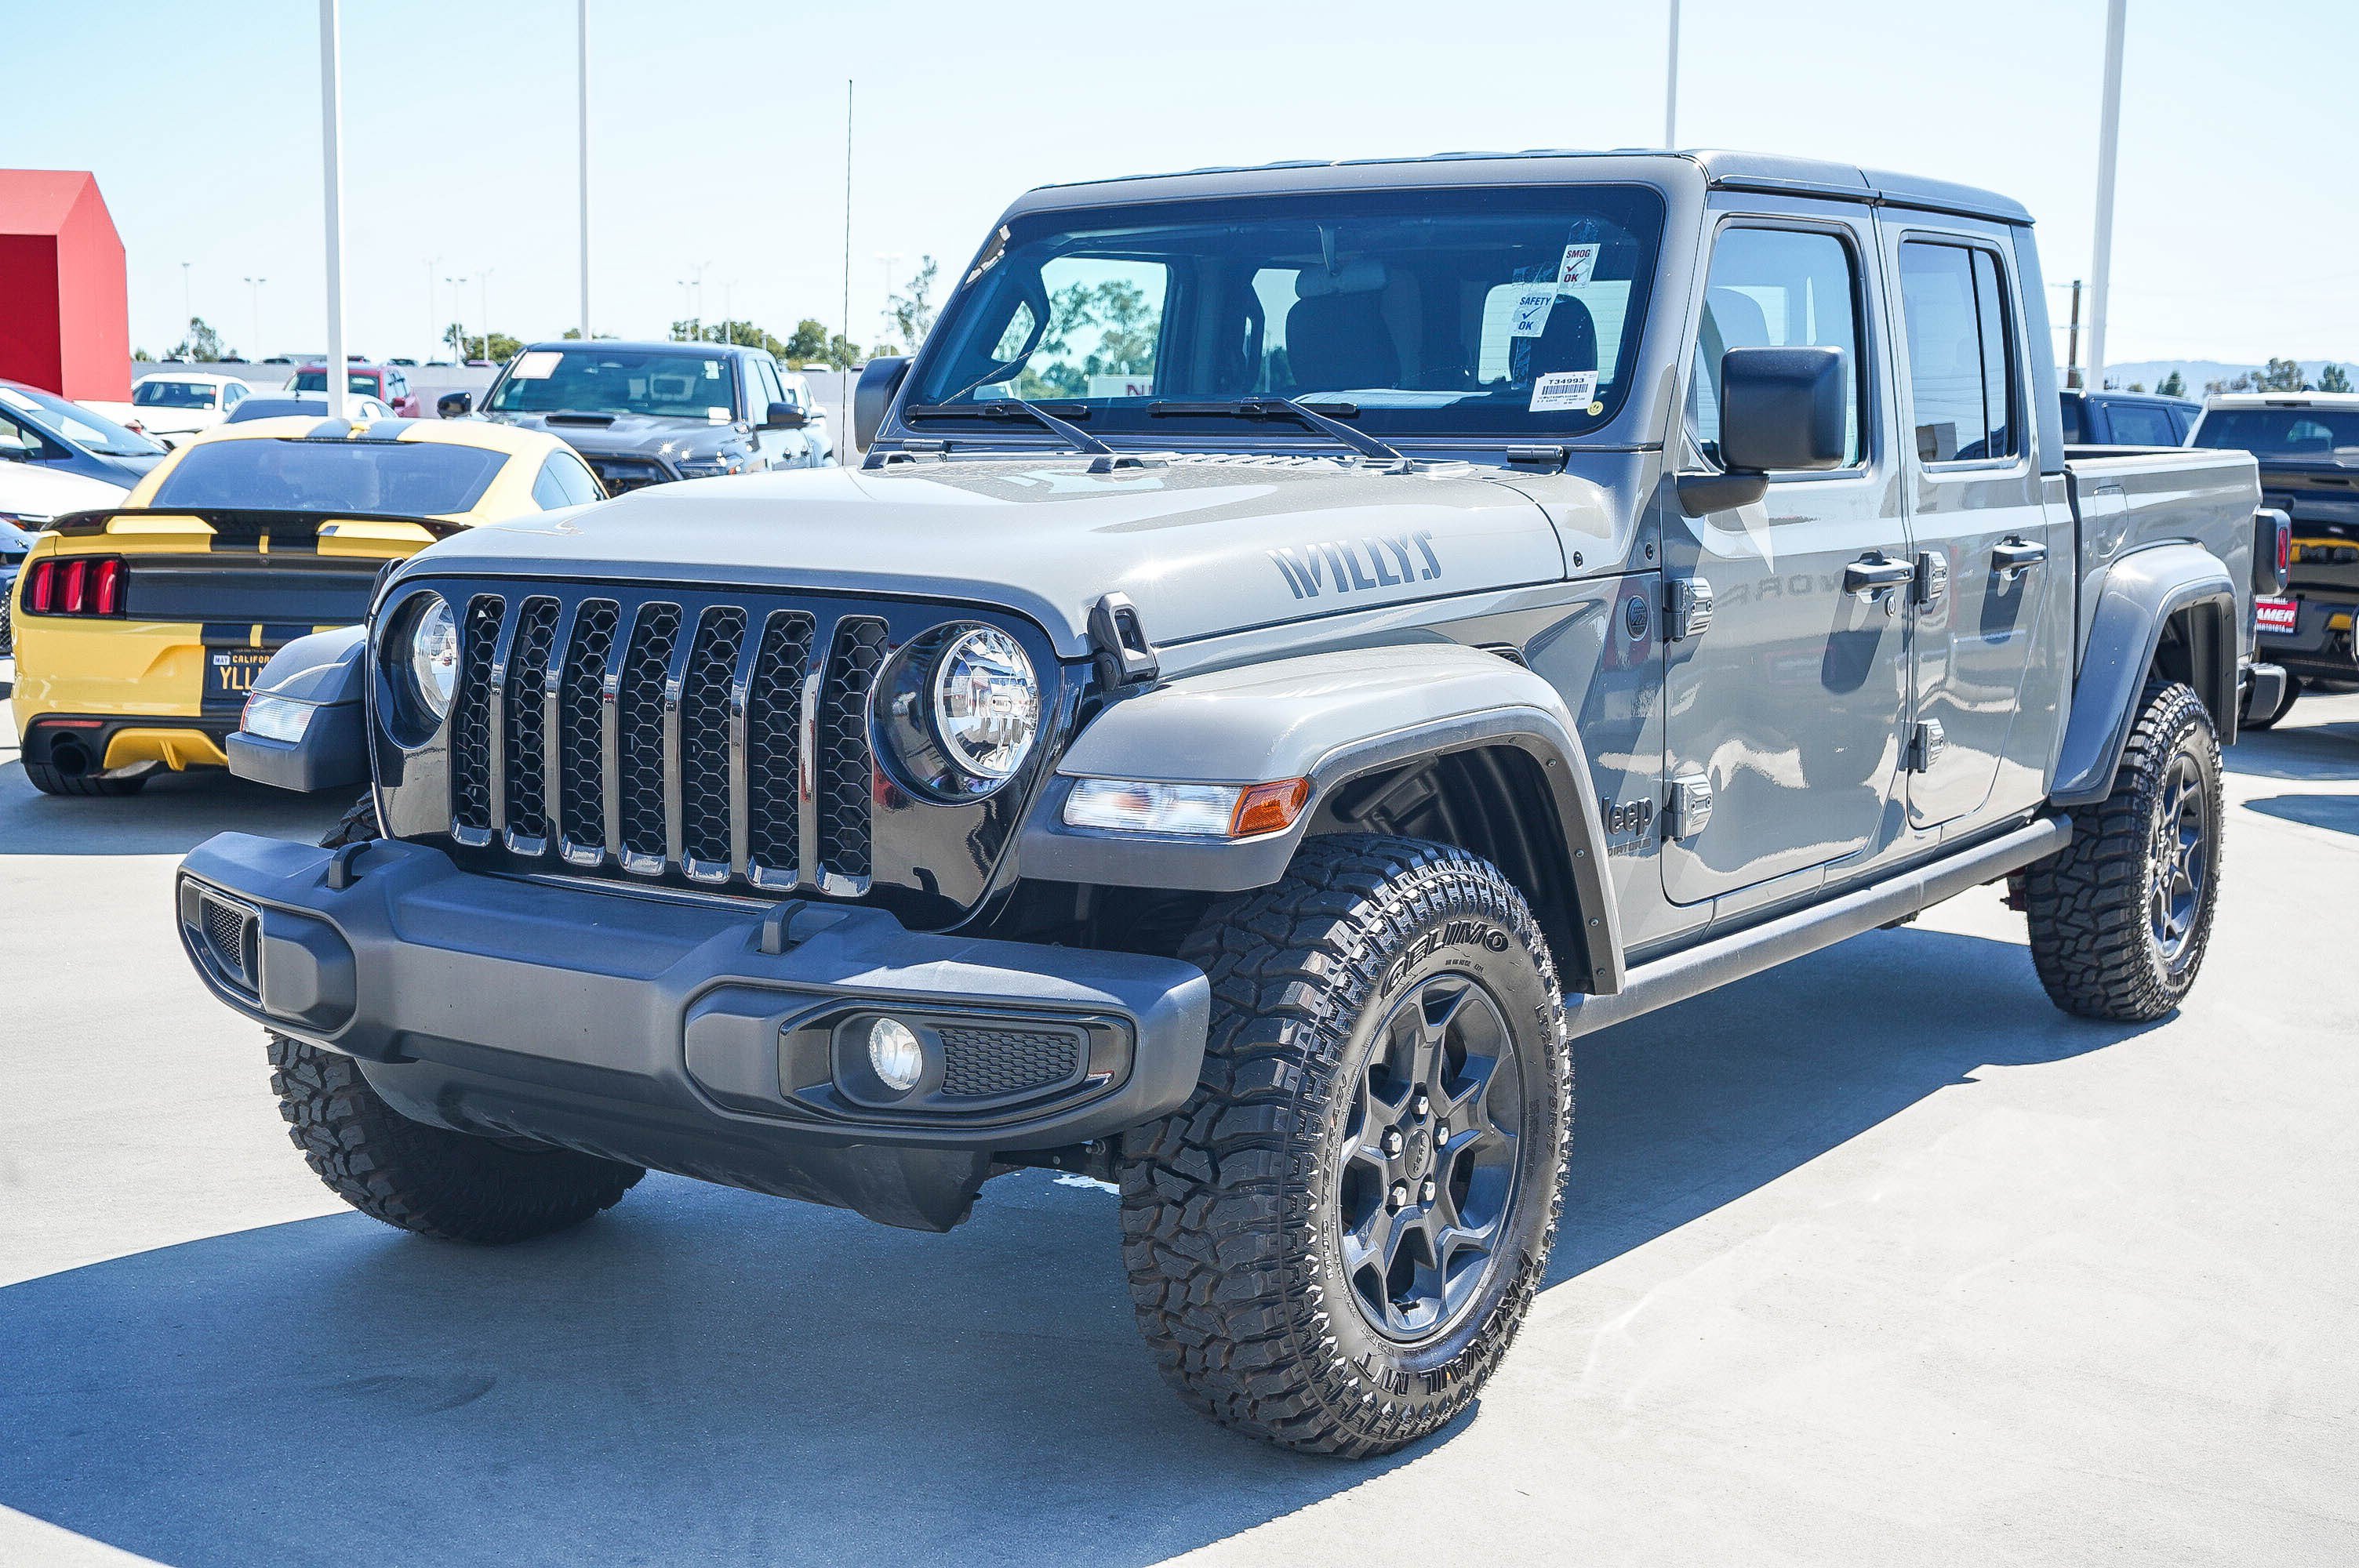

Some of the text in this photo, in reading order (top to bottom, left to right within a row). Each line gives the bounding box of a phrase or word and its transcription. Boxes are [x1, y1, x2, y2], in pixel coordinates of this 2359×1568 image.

[1565, 249, 1591, 259] SMOG
[1563, 274, 1579, 283] OK
[1519, 296, 1552, 306] SAFETY
[1518, 321, 1534, 331] OK
[1266, 528, 1441, 599] WILLYS
[2256, 608, 2295, 622] AMER
[232, 655, 272, 663] CALIFOR
[220, 666, 264, 690] YLL
[1601, 796, 1653, 836] Jeep
